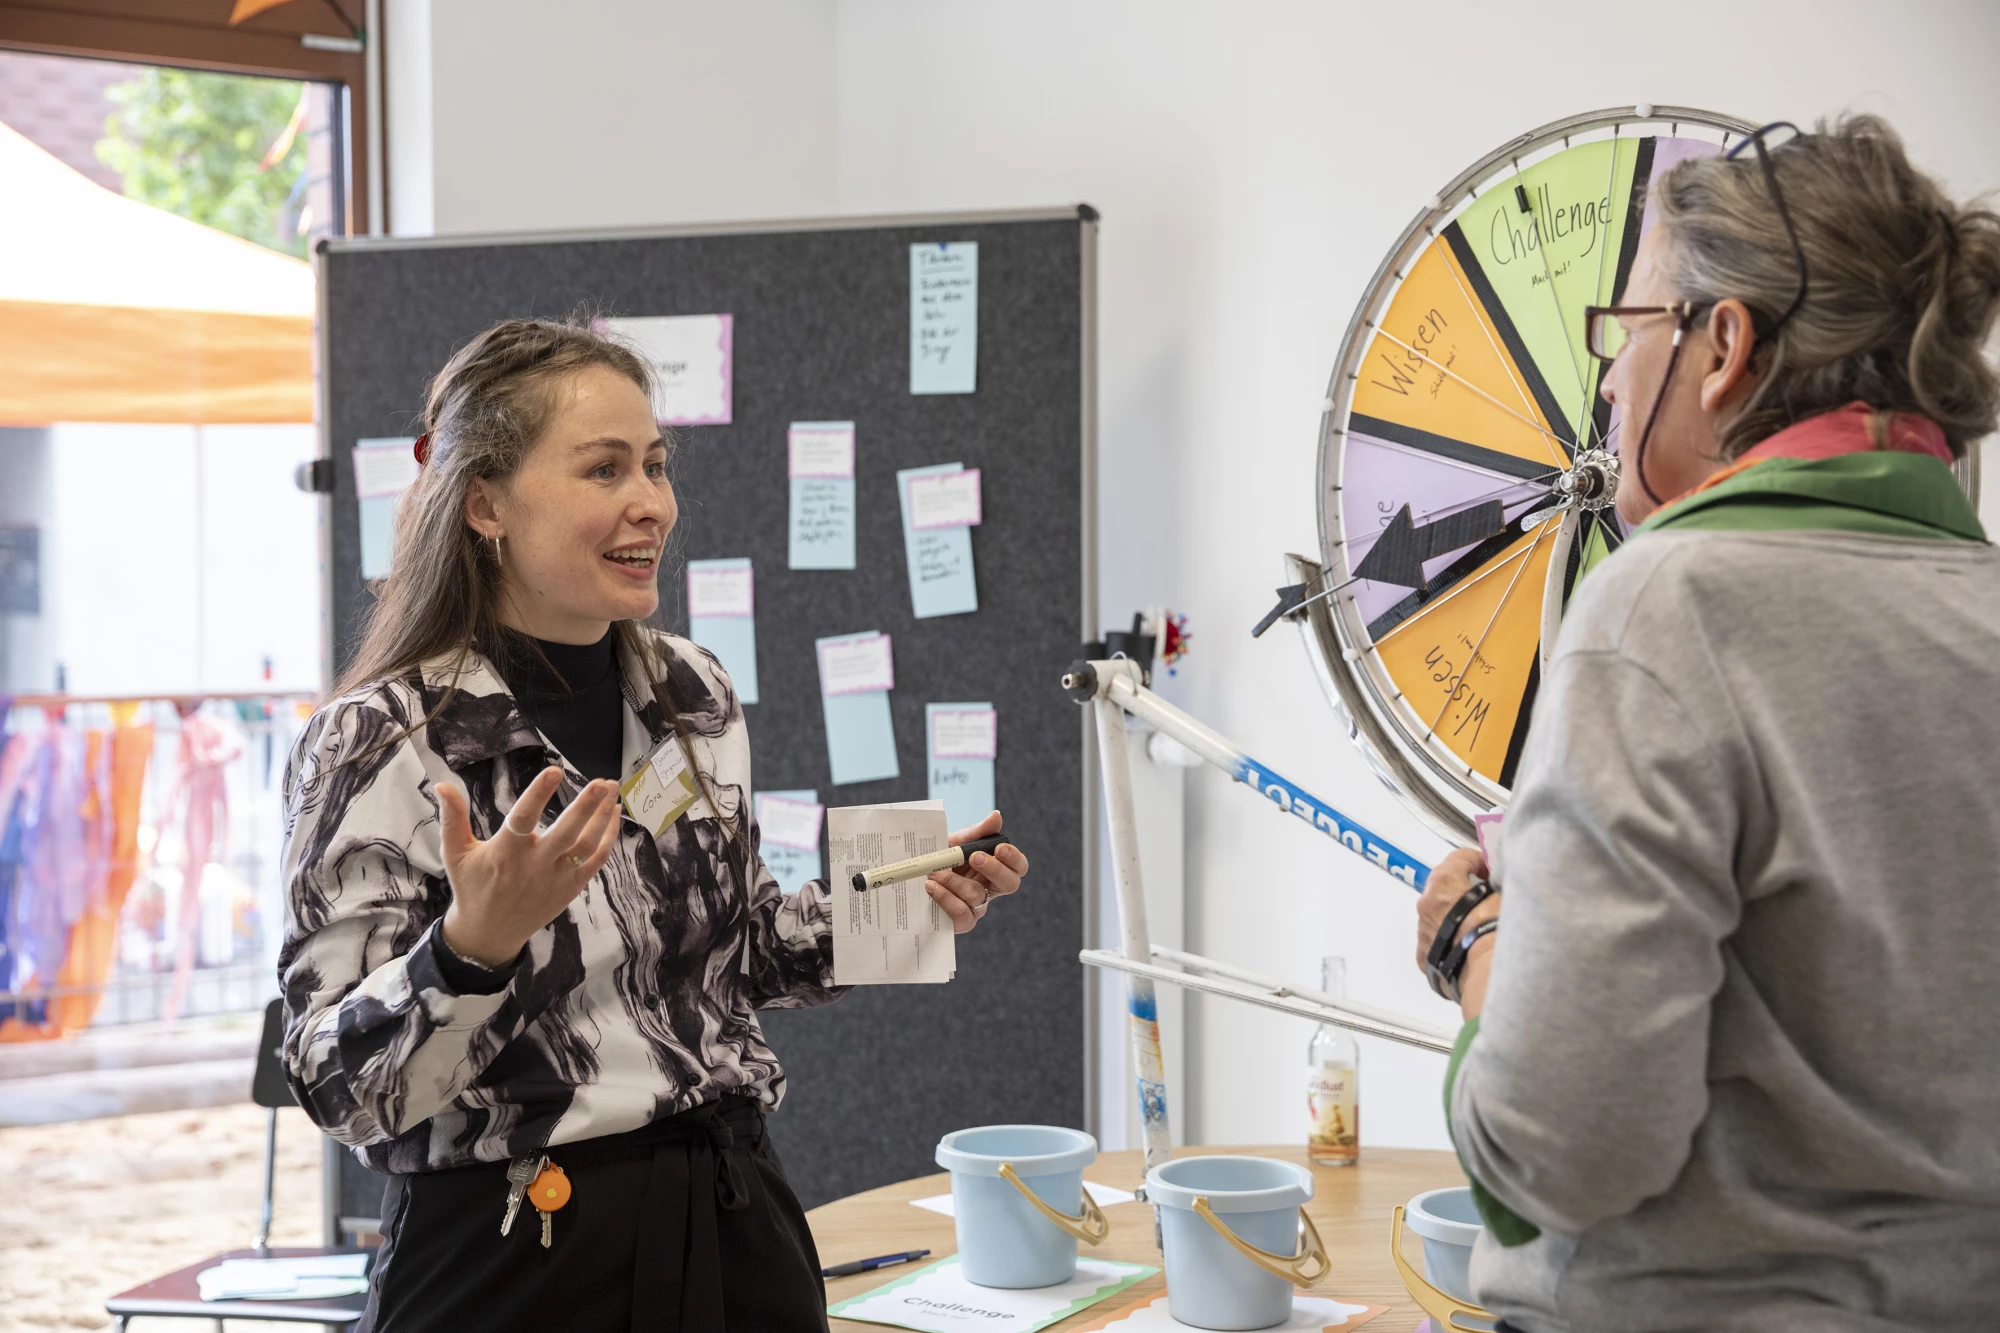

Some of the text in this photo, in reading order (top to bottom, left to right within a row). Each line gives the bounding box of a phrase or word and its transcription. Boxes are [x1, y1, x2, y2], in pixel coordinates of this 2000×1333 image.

[1491, 182, 1613, 265] Challenge
[1371, 308, 1448, 396] Wissen
[1425, 645, 1491, 753] Wissen
[642, 792, 663, 814] Cora
[903, 1297, 1016, 1320] Challenge
